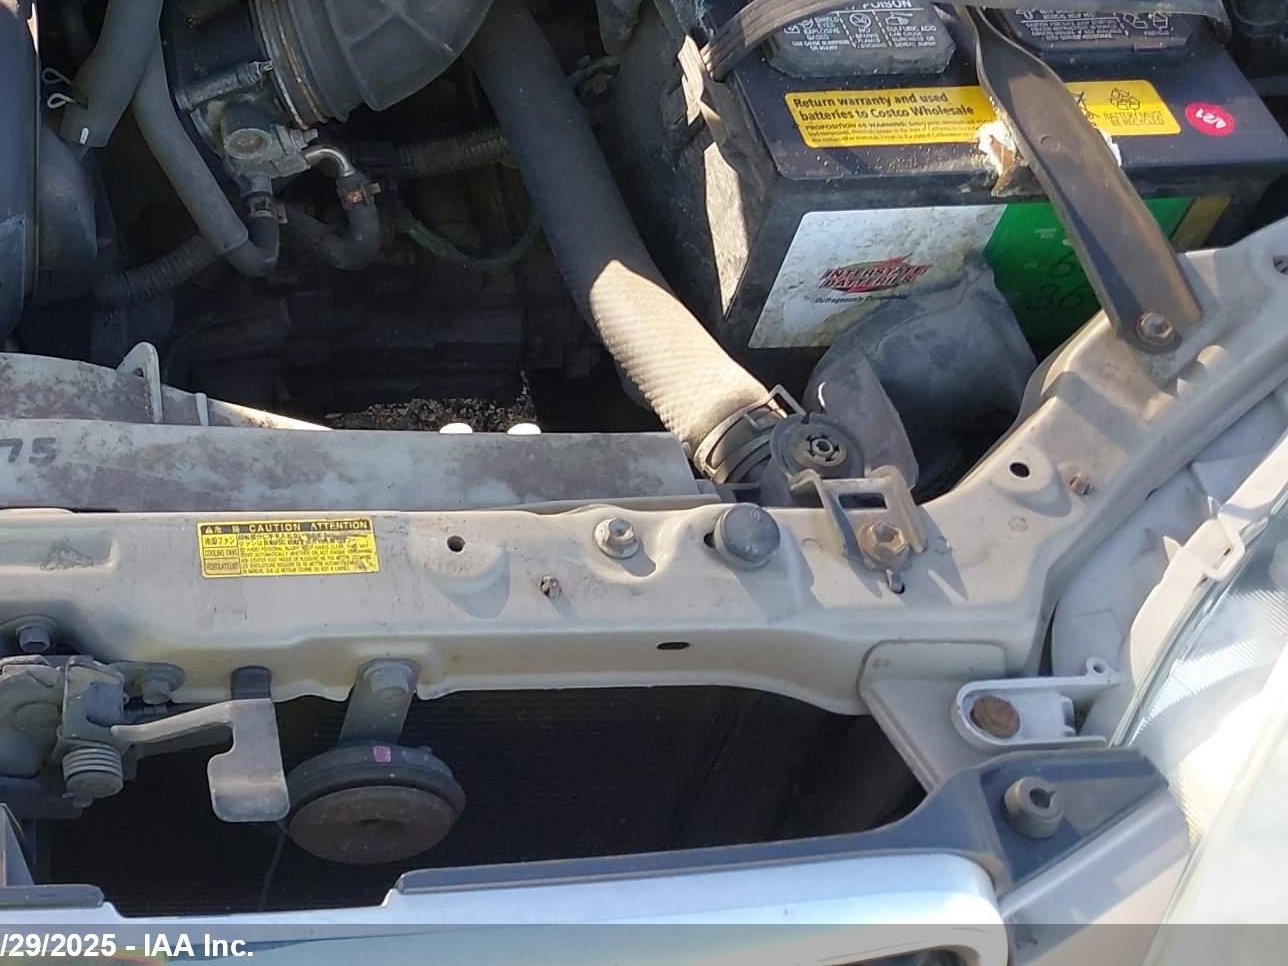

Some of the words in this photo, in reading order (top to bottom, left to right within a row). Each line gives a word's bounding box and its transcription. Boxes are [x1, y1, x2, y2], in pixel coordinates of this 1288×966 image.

[793, 98, 836, 108] Return
[837, 96, 891, 108] warranty
[894, 93, 920, 104] and
[921, 92, 948, 103] used
[800, 108, 854, 121] batteries
[856, 108, 869, 119] to
[870, 106, 910, 118] Costco
[911, 104, 974, 118] Wholesale
[248, 522, 301, 533] CAUTION
[310, 520, 368, 532] ATTENTION
